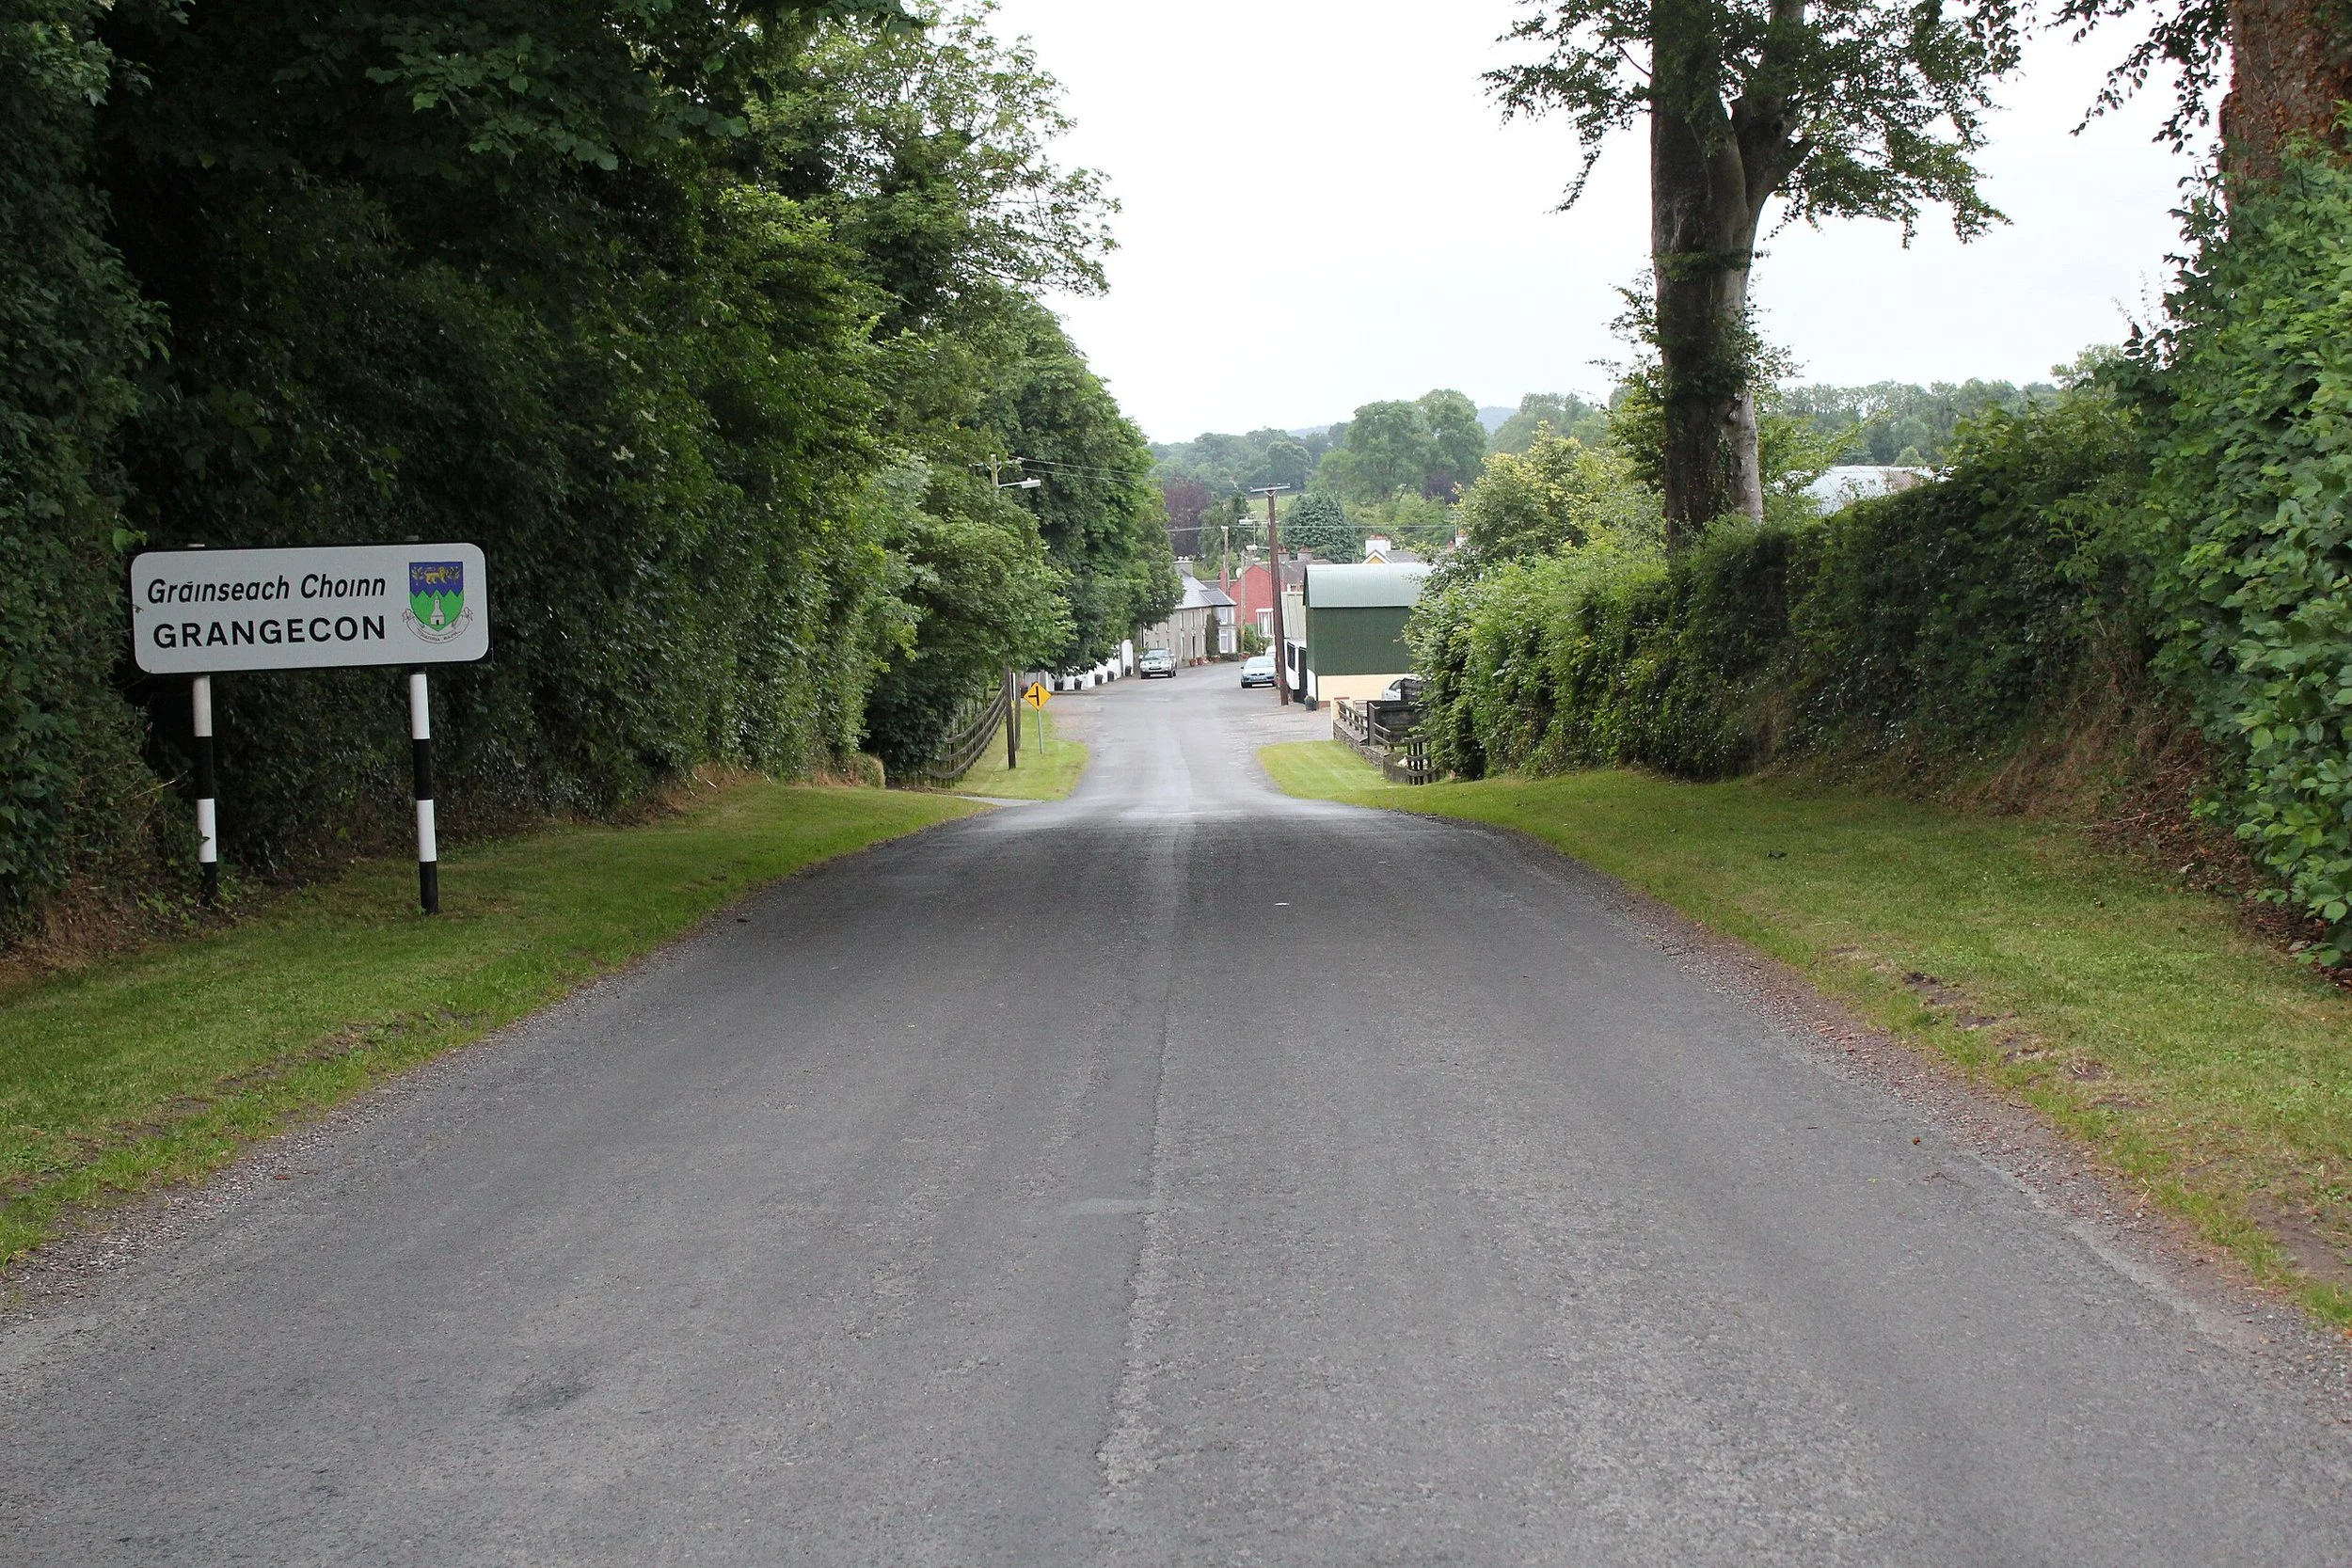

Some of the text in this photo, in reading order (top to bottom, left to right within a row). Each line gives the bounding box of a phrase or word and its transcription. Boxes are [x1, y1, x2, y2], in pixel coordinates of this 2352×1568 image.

[148, 573, 386, 605] Gráinseach Choinn
[152, 614, 386, 649] GRANGECON
